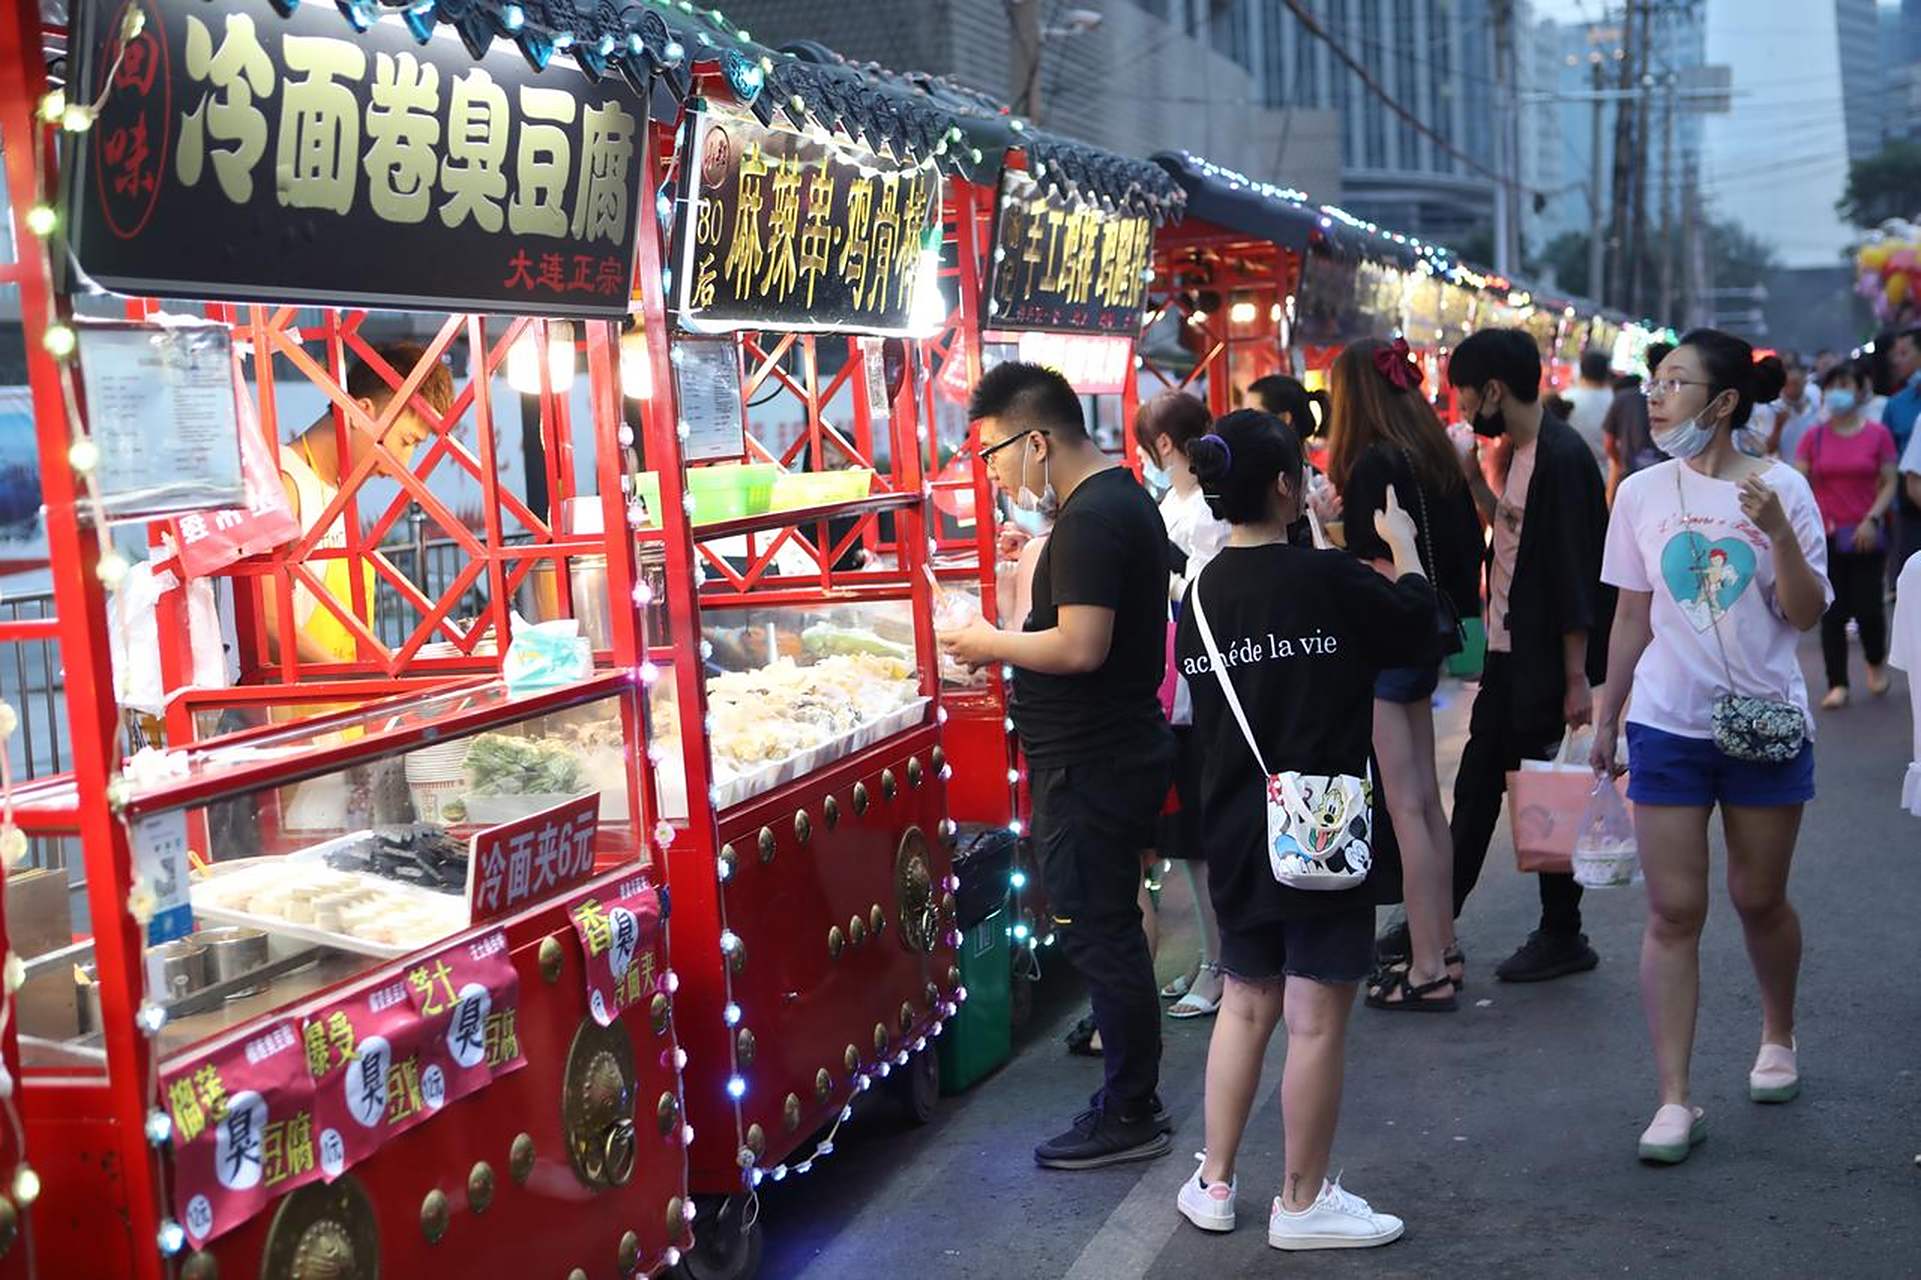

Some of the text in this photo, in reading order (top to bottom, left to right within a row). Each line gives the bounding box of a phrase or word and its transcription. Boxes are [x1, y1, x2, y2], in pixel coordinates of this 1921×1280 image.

[176, 13, 634, 247] 冷面卷臭豆腐
[503, 249, 627, 295] 大连正宗
[1267, 634, 1295, 659] la
[1299, 629, 1337, 654] vie
[477, 810, 595, 910] 冷面夹6元
[409, 960, 463, 1016] 芝士
[225, 1107, 261, 1183] 臭
[262, 1109, 315, 1187] 豆腐
